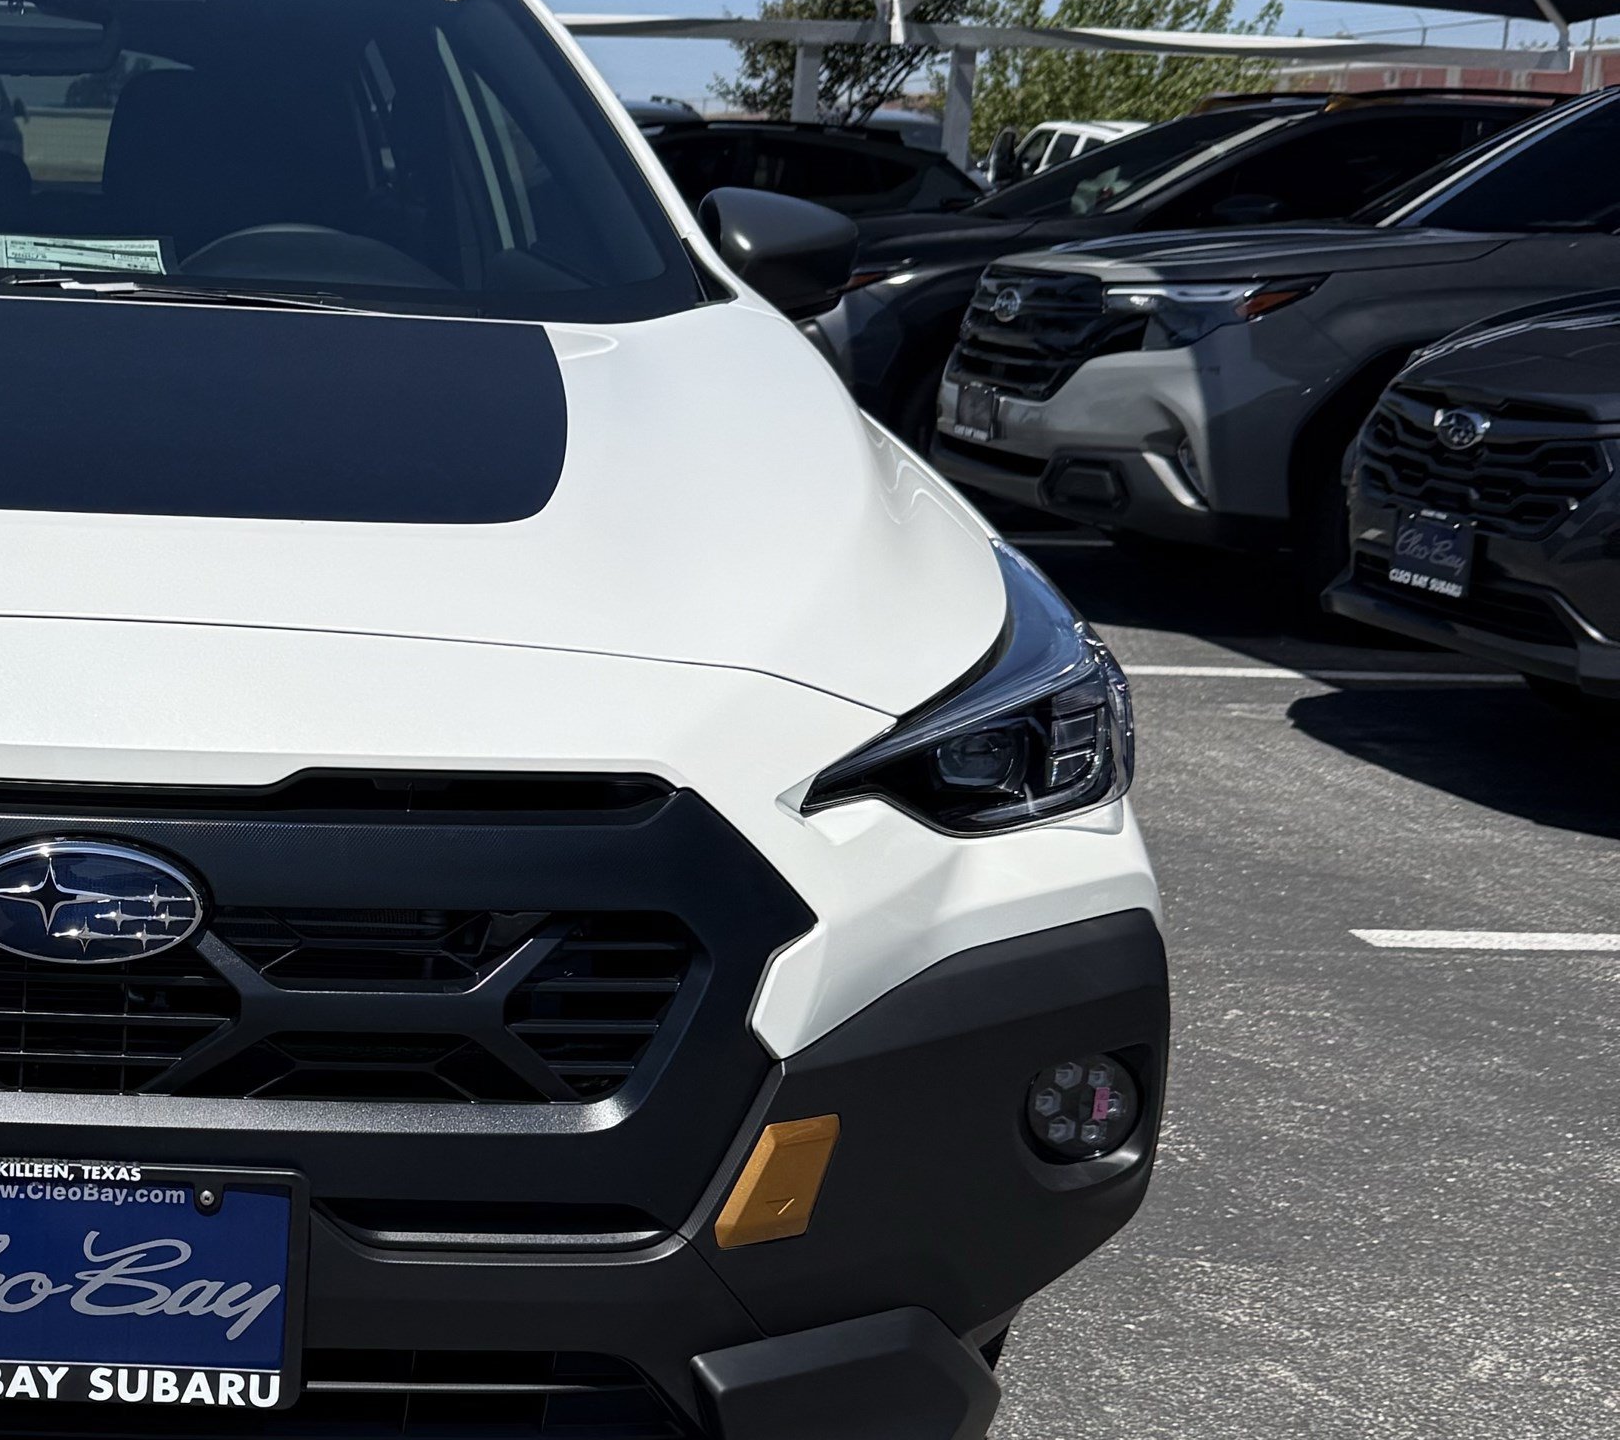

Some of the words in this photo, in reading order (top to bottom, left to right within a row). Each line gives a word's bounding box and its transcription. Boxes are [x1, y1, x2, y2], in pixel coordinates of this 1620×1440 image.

[82, 1165, 142, 1182] TEXAS
[69, 1230, 281, 1341] Bay
[87, 1368, 281, 1409] SUBARU
